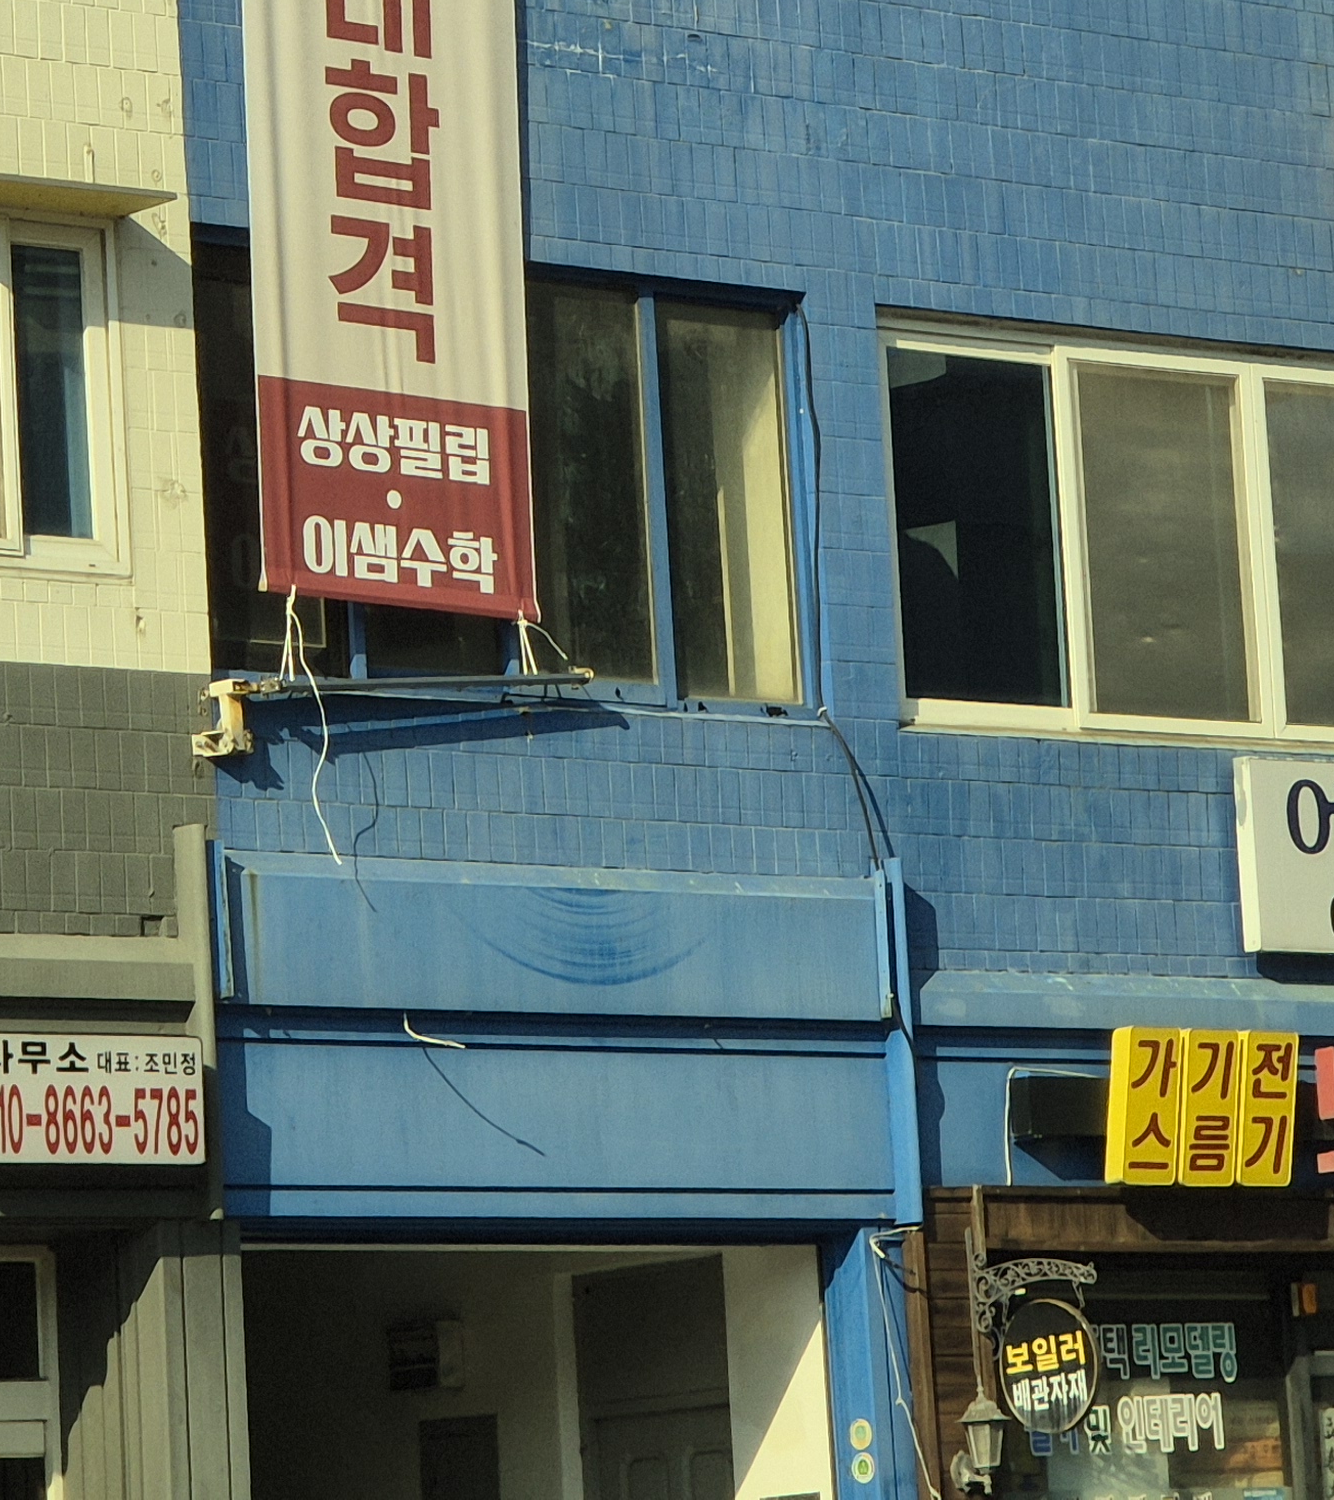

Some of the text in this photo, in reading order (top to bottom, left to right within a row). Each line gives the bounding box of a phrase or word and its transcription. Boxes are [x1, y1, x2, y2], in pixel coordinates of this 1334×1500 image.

[297, 405, 490, 485] 상상필립
[302, 515, 498, 594] 이샘수학
[144, 1052, 196, 1075] 조민정
[1006, 1330, 1085, 1374] 보일러
[1132, 1322, 1237, 1383] 리모델링
[1012, 1369, 1088, 1411] 배관자재
[1117, 1392, 1225, 1454] 인테리어
